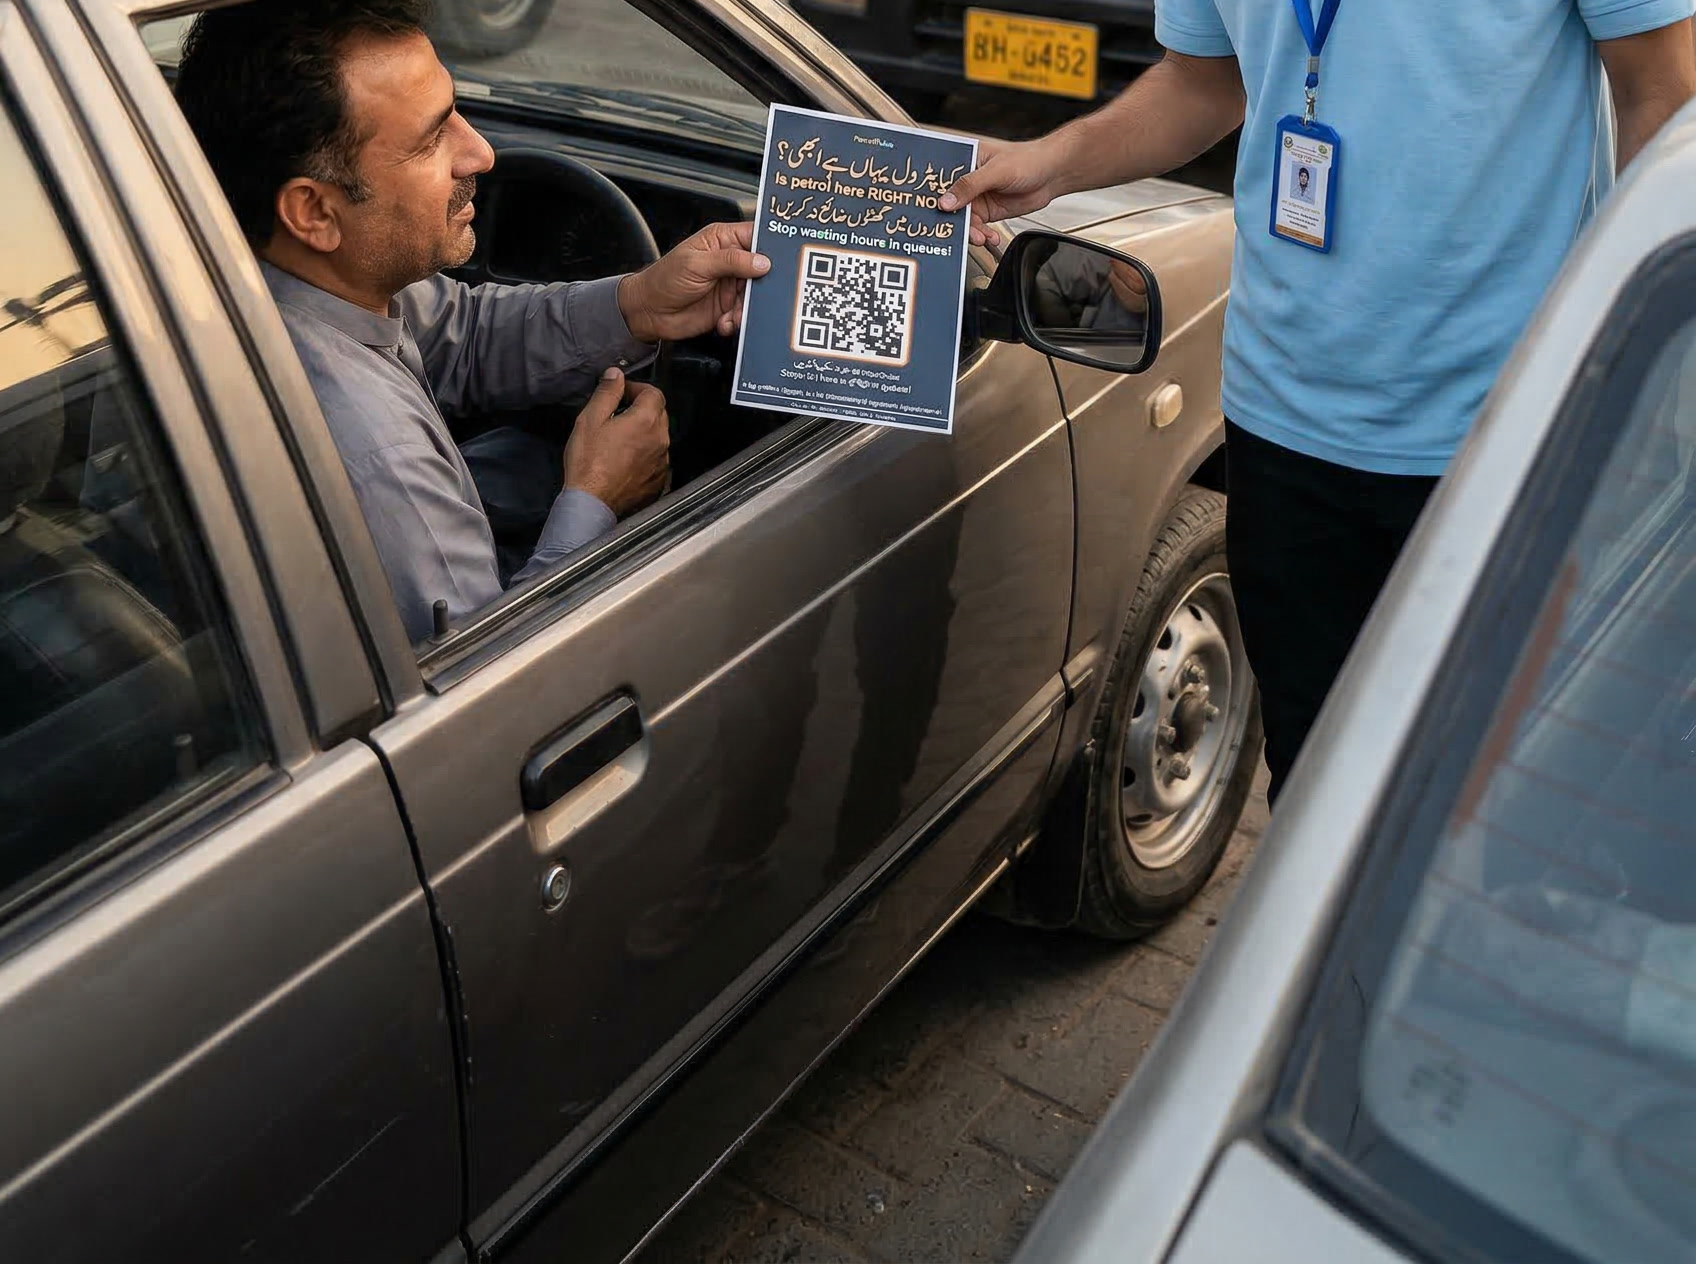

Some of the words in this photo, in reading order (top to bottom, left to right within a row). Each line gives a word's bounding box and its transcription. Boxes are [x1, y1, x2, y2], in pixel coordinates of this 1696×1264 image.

[849, 156, 889, 184] یہاں
[775, 171, 788, 186] Is
[790, 177, 832, 193] petrol
[834, 181, 865, 198] here
[867, 187, 912, 205] RIGHT
[915, 195, 940, 210] NO
[768, 220, 798, 238] Stop
[800, 227, 848, 245] wasting
[850, 232, 887, 249] hours
[888, 238, 901, 250] in
[903, 242, 953, 257] queues!
